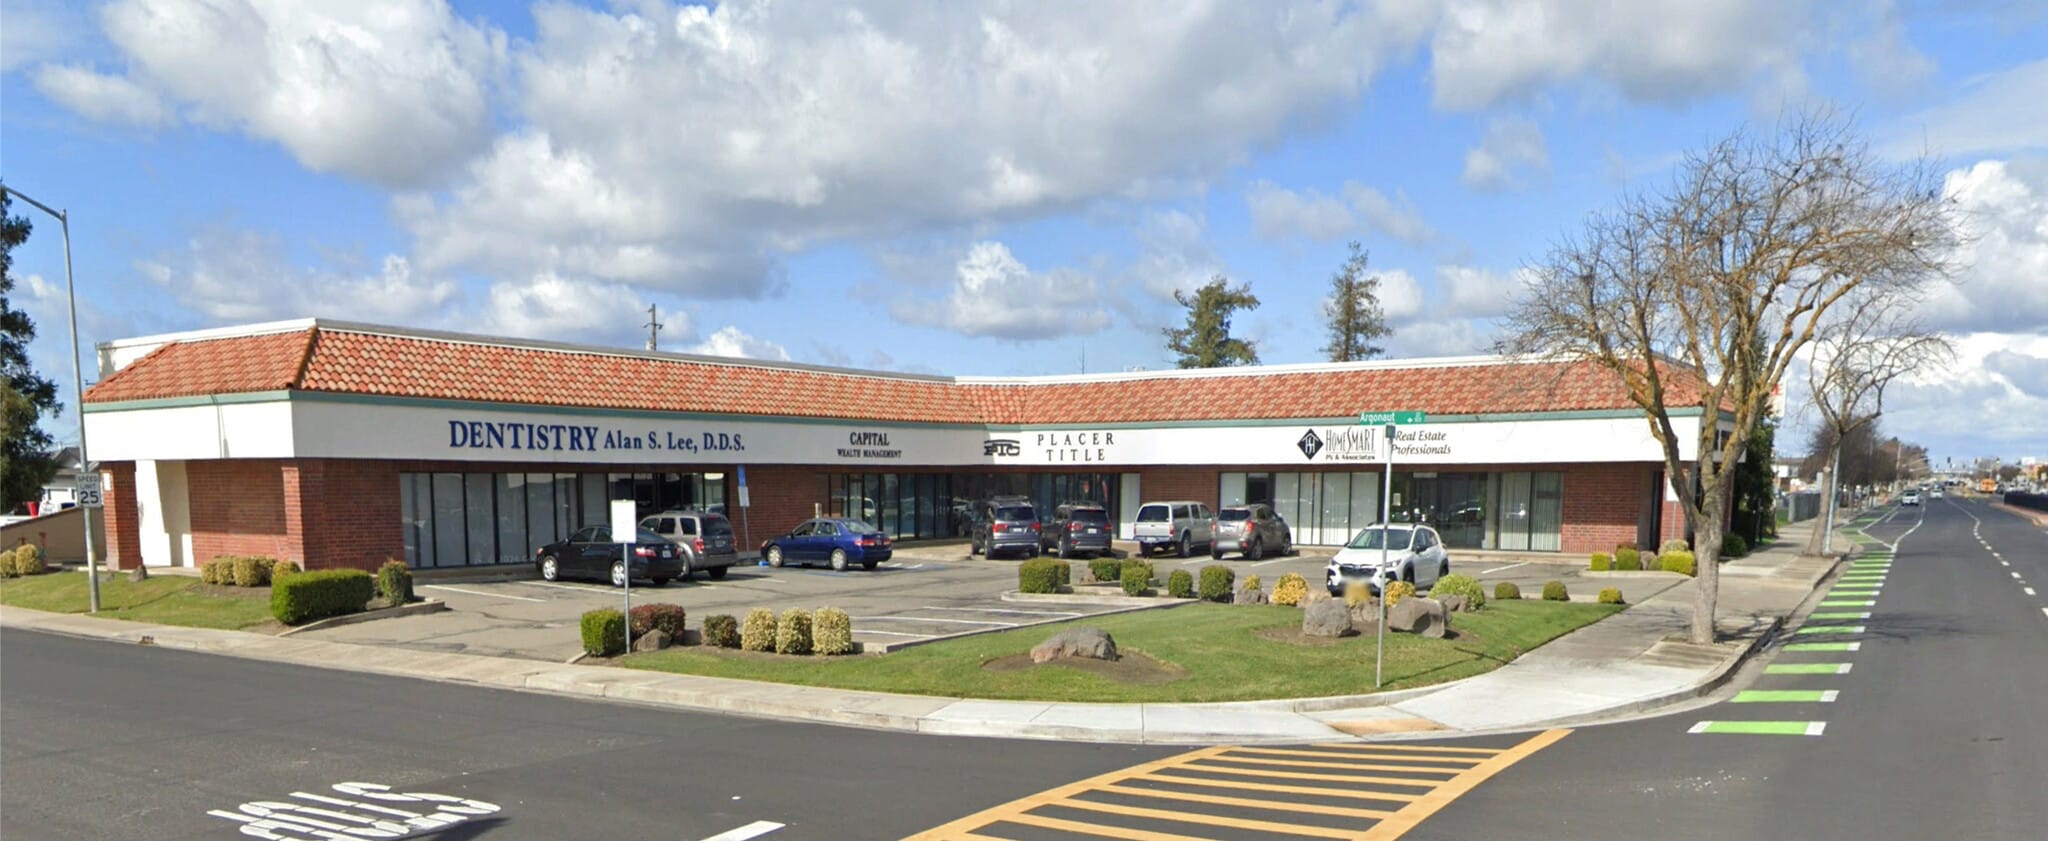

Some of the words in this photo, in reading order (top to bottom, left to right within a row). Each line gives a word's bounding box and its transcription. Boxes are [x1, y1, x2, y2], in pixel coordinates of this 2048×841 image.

[1359, 412, 1396, 425] Argonaut
[448, 420, 599, 452] DENTISTRY
[604, 430, 642, 450] Alan
[648, 431, 662, 450] S.
[667, 432, 698, 454] Lee,
[703, 433, 745, 452] D.D.S.
[850, 432, 890, 446] CAPITAL
[1038, 433, 1114, 446] PLACER
[1396, 430, 1416, 441] Real
[1418, 430, 1447, 441] Estate
[837, 448, 861, 458] WEALTH
[863, 449, 902, 458] MANAGEMENT
[1046, 449, 1105, 462] TITLE
[1392, 444, 1452, 456] Professionals
[80, 491, 99, 504] 25
